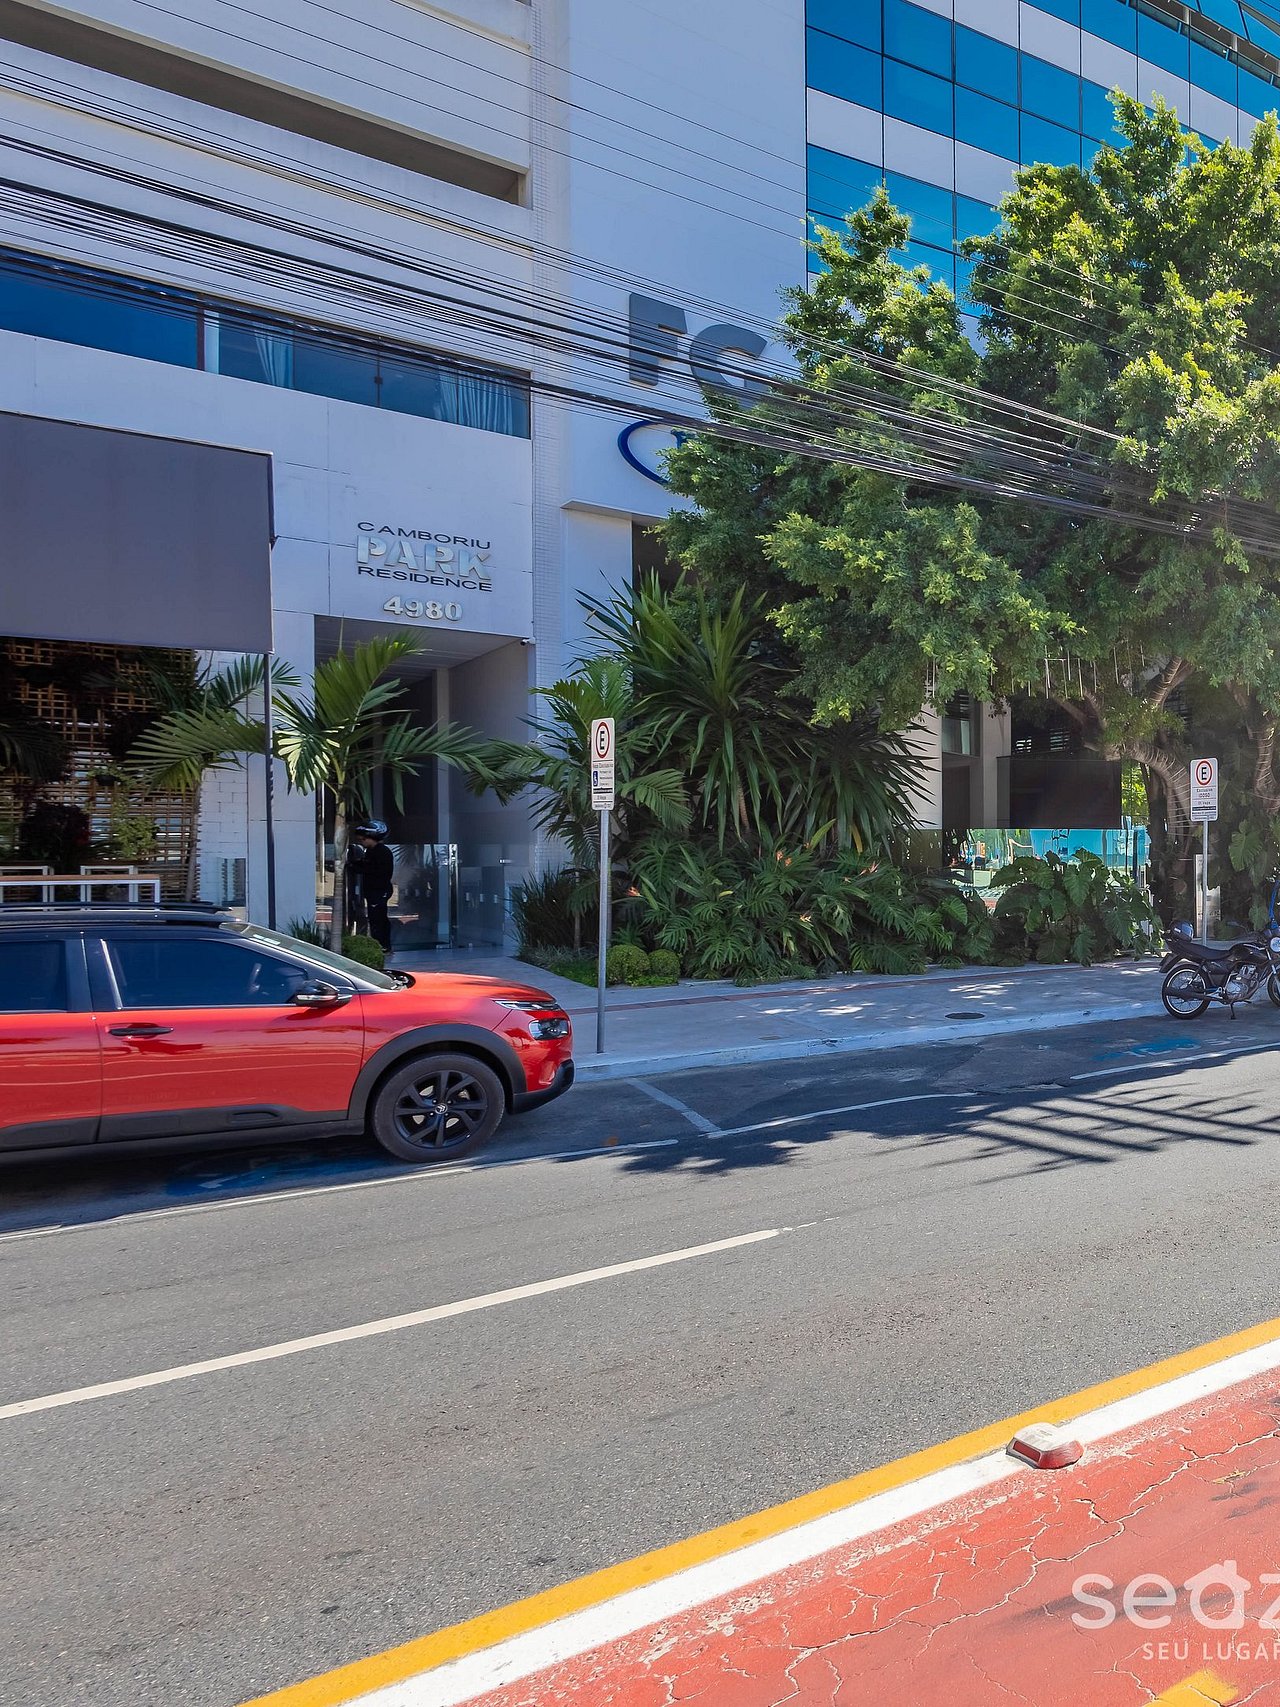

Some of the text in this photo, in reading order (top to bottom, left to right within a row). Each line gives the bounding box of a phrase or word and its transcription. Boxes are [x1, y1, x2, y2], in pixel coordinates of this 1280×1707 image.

[357, 521, 491, 549] CAMBORIU
[357, 535, 492, 580] PARK
[357, 566, 493, 592] RESIDENCE
[383, 595, 463, 621] 4980
[600, 730, 605, 750] E
[1201, 767, 1207, 780] E
